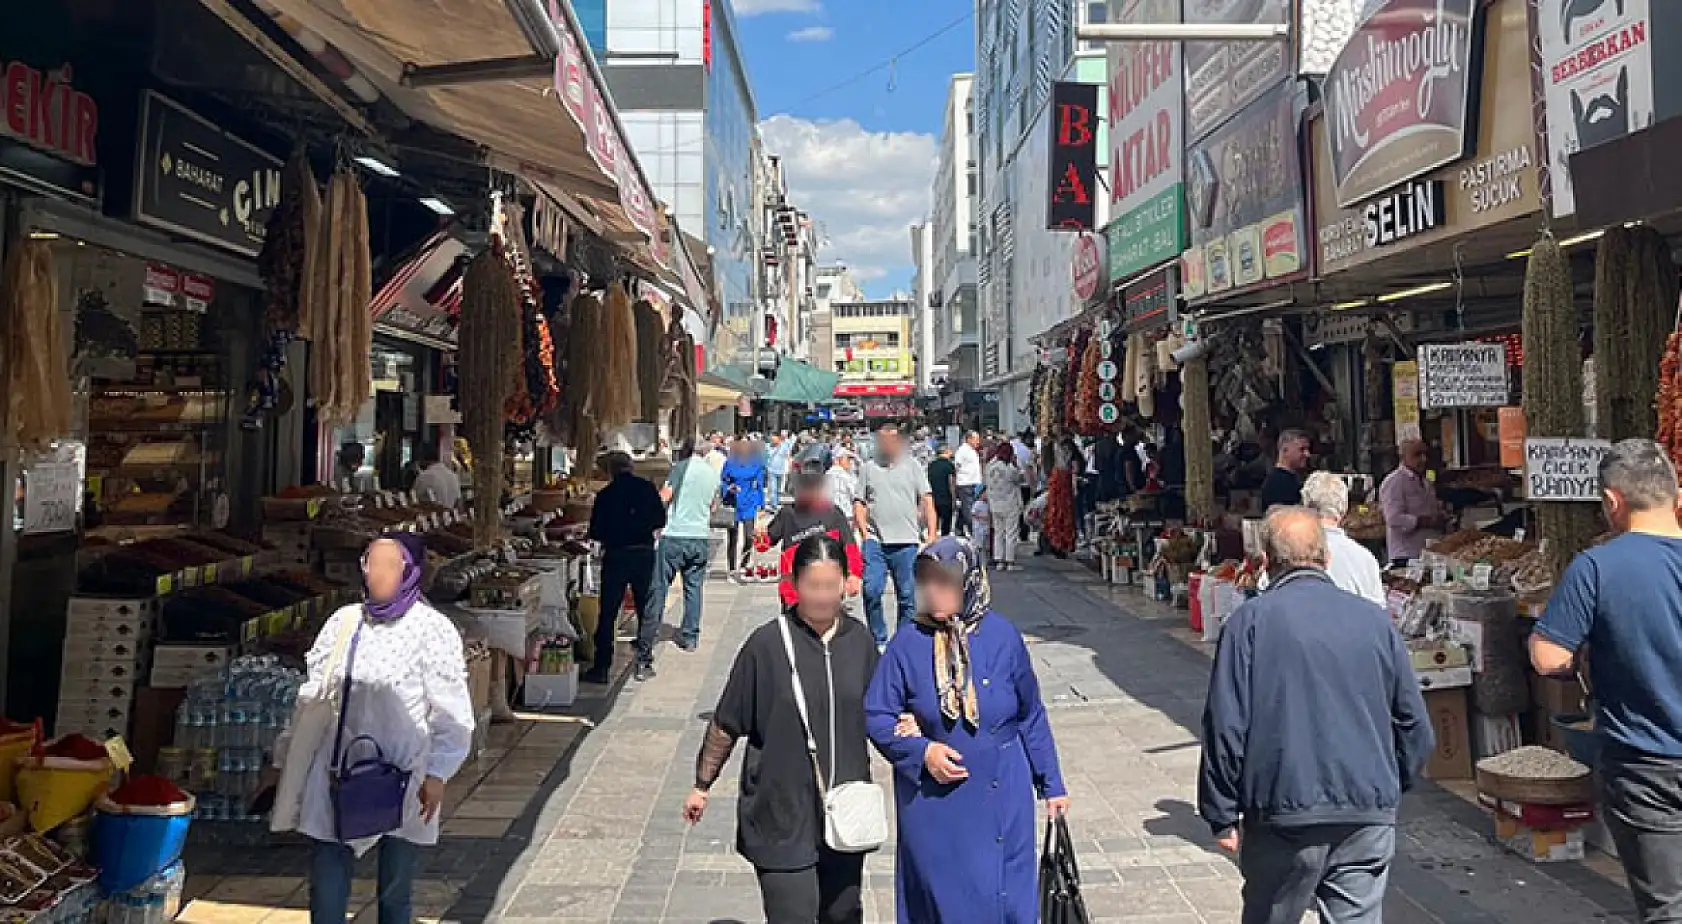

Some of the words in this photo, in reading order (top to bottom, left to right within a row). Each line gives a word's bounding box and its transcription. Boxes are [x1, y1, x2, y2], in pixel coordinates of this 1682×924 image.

[0, 62, 98, 166] EKİR
[1111, 108, 1172, 205] AKTAR
[1460, 144, 1531, 191] PASTIRMA
[1366, 179, 1434, 248] SELİN
[1471, 175, 1521, 213] SUCUK
[1528, 445, 1603, 460] KAMPANY
